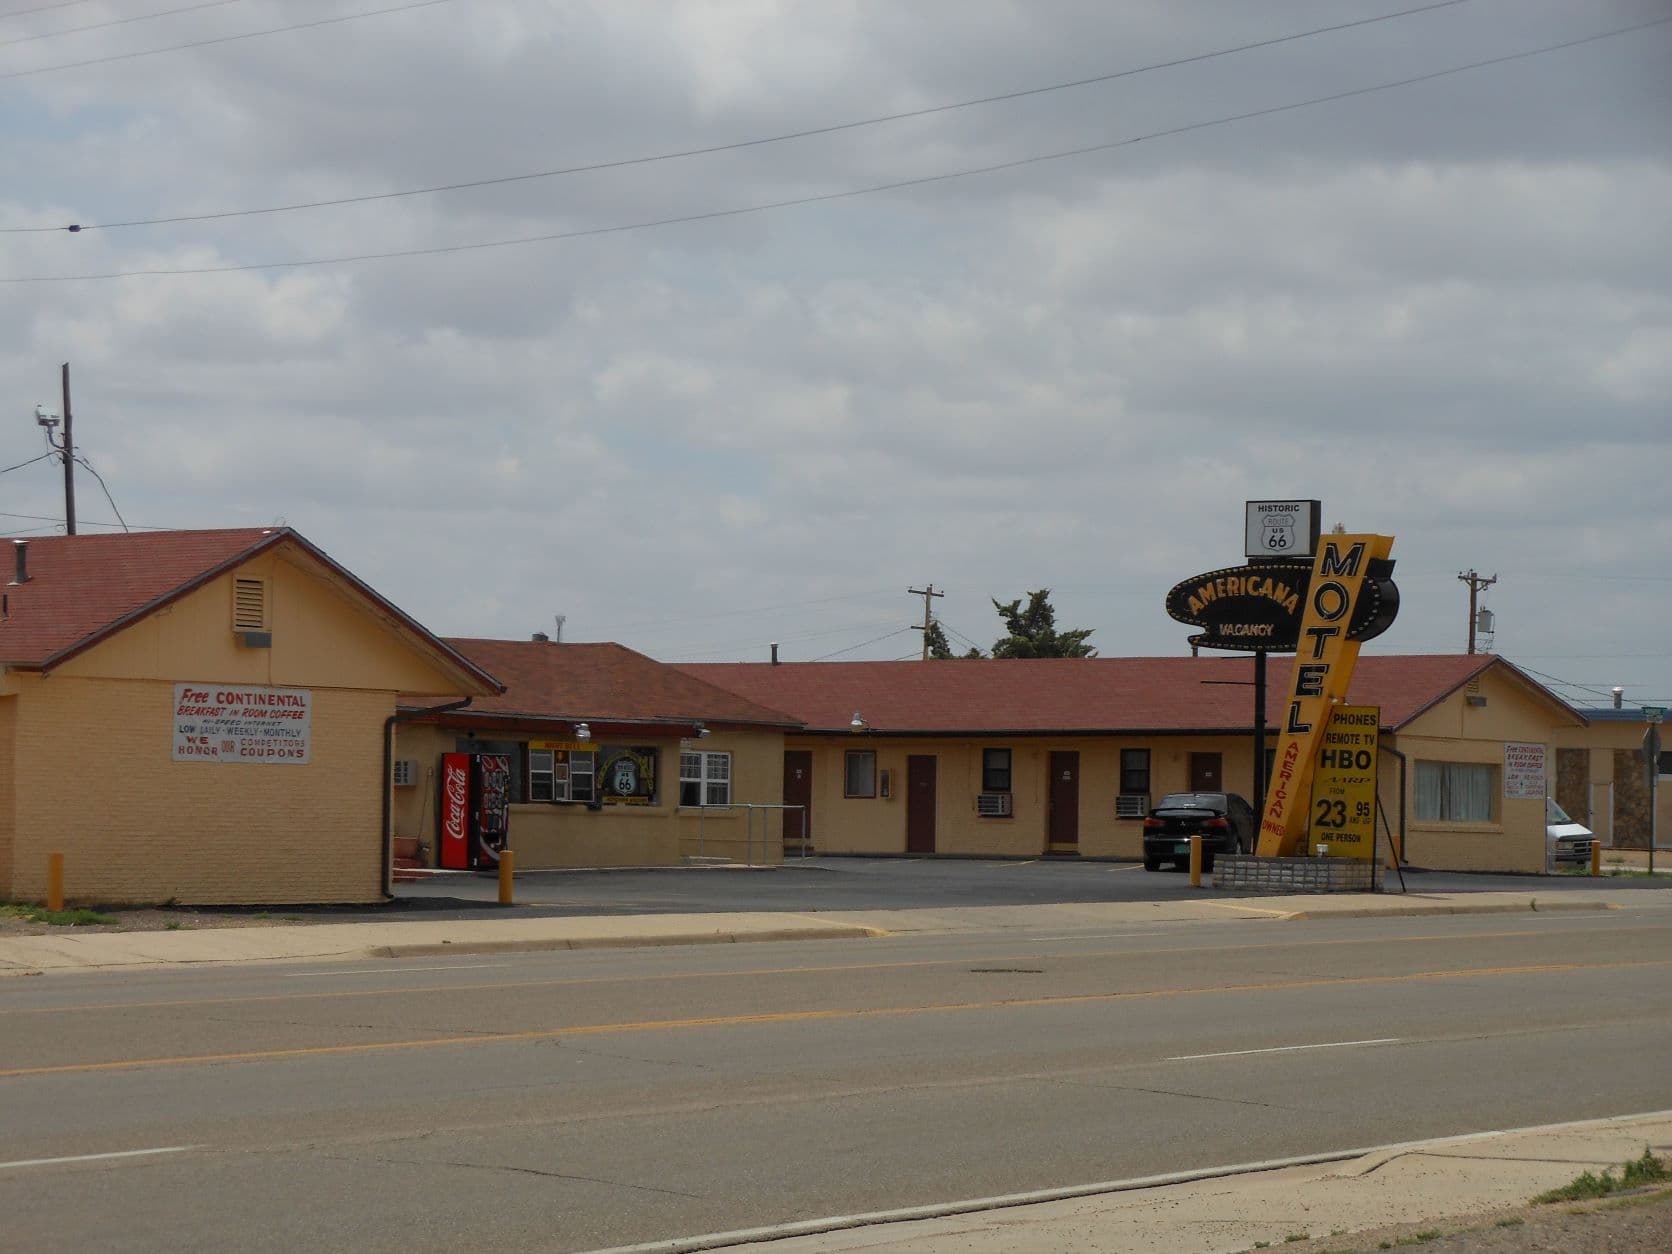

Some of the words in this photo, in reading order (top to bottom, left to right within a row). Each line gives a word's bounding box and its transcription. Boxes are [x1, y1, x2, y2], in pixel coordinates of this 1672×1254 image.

[1258, 504, 1300, 512] HISTORIC
[1267, 518, 1289, 526] ROUTE
[1269, 535, 1287, 548] 66
[1188, 576, 1299, 616] AMERICANA
[1219, 623, 1274, 636] VACANCY
[1287, 542, 1366, 735] MOTEL
[182, 688, 209, 703] Free
[216, 692, 306, 707] CONTINENTAL
[177, 705, 226, 717] BREAKFAST
[242, 708, 267, 718] ROOM
[270, 710, 304, 719] COFFEE
[1333, 713, 1376, 726] PHONES
[179, 725, 196, 734] LOW
[187, 735, 208, 744] WE
[240, 738, 305, 747] COMPETITORS
[1326, 733, 1360, 744] REMOTE
[1364, 734, 1375, 745] TV
[178, 746, 218, 756] HONOR
[240, 748, 304, 758] COUPONS
[1321, 749, 1372, 769] HBO
[619, 777, 631, 790] 66
[1270, 742, 1299, 818] AMERICAN
[1315, 798, 1347, 828] 23
[1356, 801, 1370, 817] 95
[1321, 831, 1334, 841] ONE
[1336, 832, 1361, 842] PERSON
